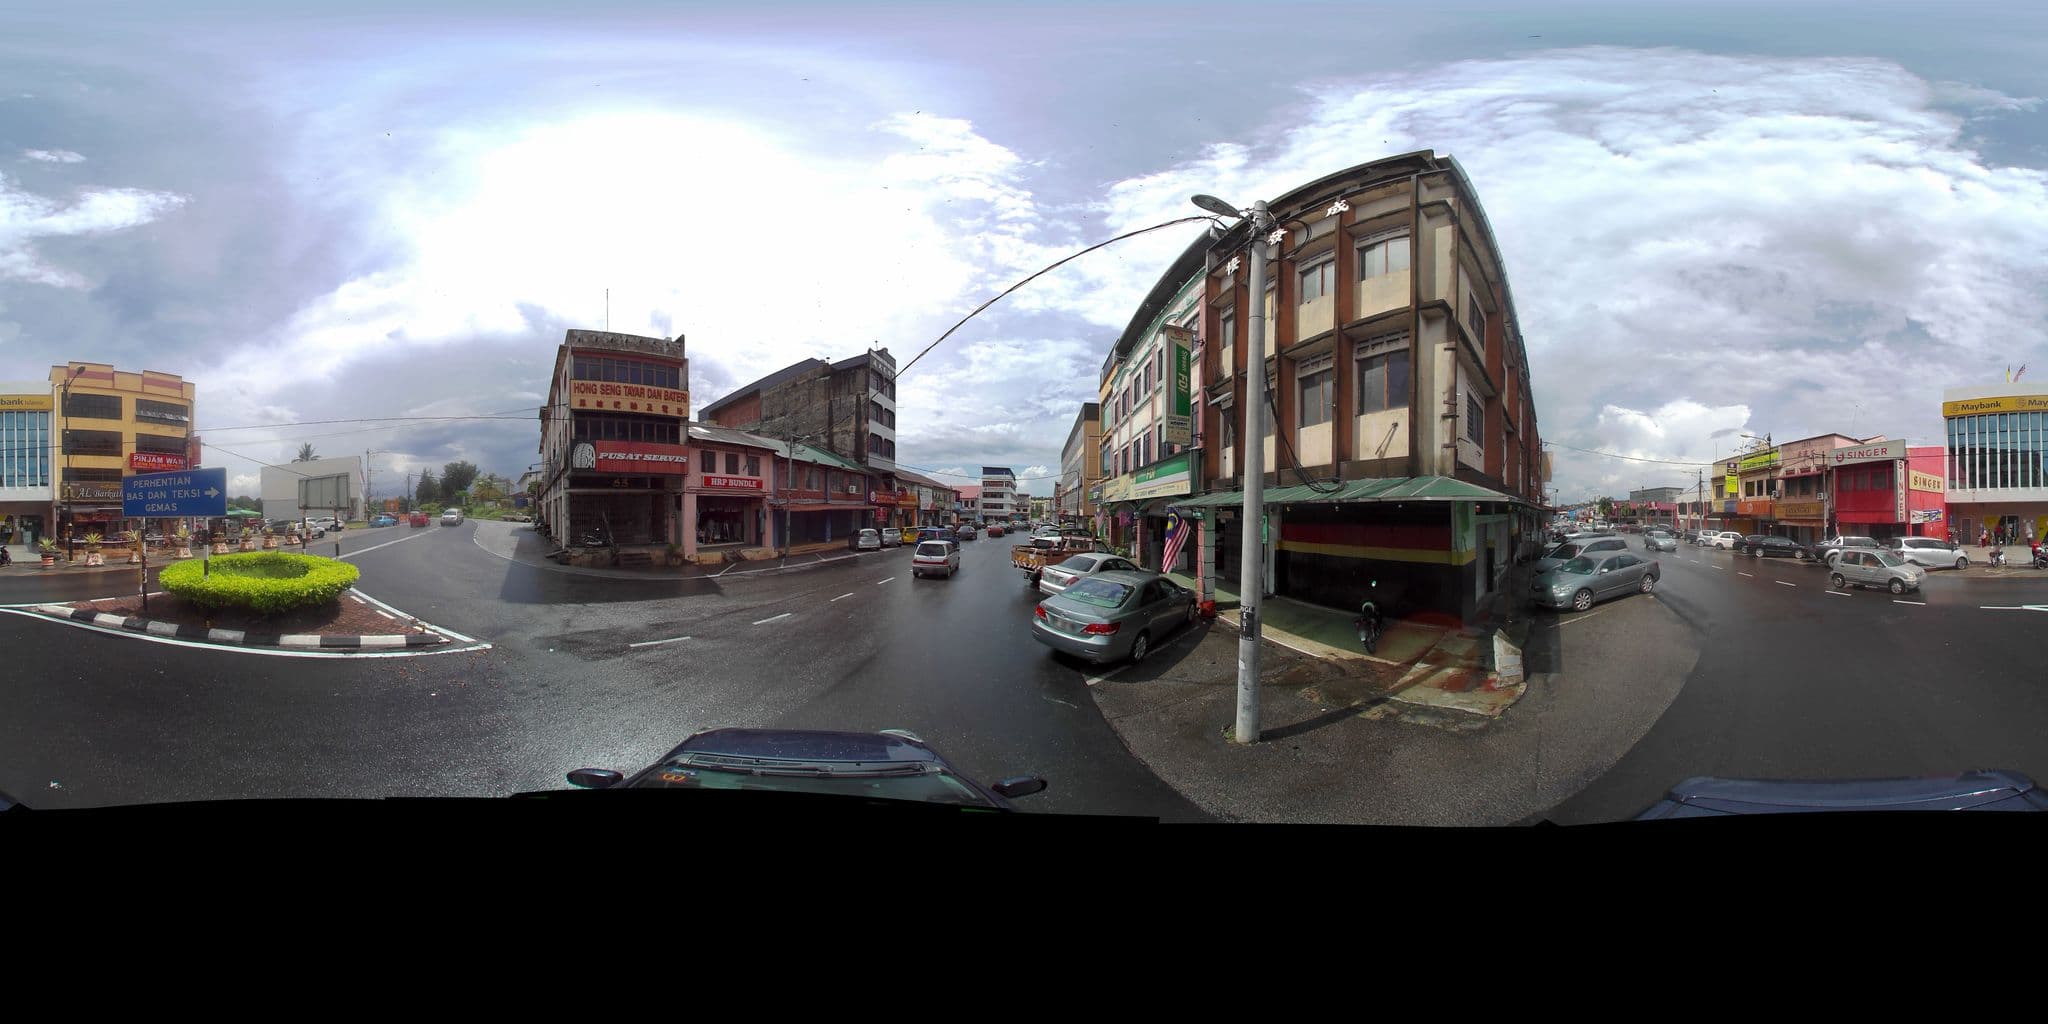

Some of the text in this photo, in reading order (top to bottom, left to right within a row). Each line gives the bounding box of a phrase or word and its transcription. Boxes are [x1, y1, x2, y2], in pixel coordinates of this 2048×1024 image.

[574, 383, 687, 404] HONG SENG TAYAR DAN BATERI
[1961, 401, 2001, 411] Maybank
[598, 452, 688, 463] PUSAT SERVIS
[1852, 447, 1888, 459] SINGER
[133, 455, 164, 464] PINJAM
[165, 457, 186, 465] WAN
[133, 476, 191, 488] PERHENTIAN
[711, 477, 757, 488] HRP BUNDLE
[1913, 476, 1941, 489] SINGER
[127, 489, 200, 501] BAS DAN TEKSI
[145, 503, 178, 512] GEMAS
